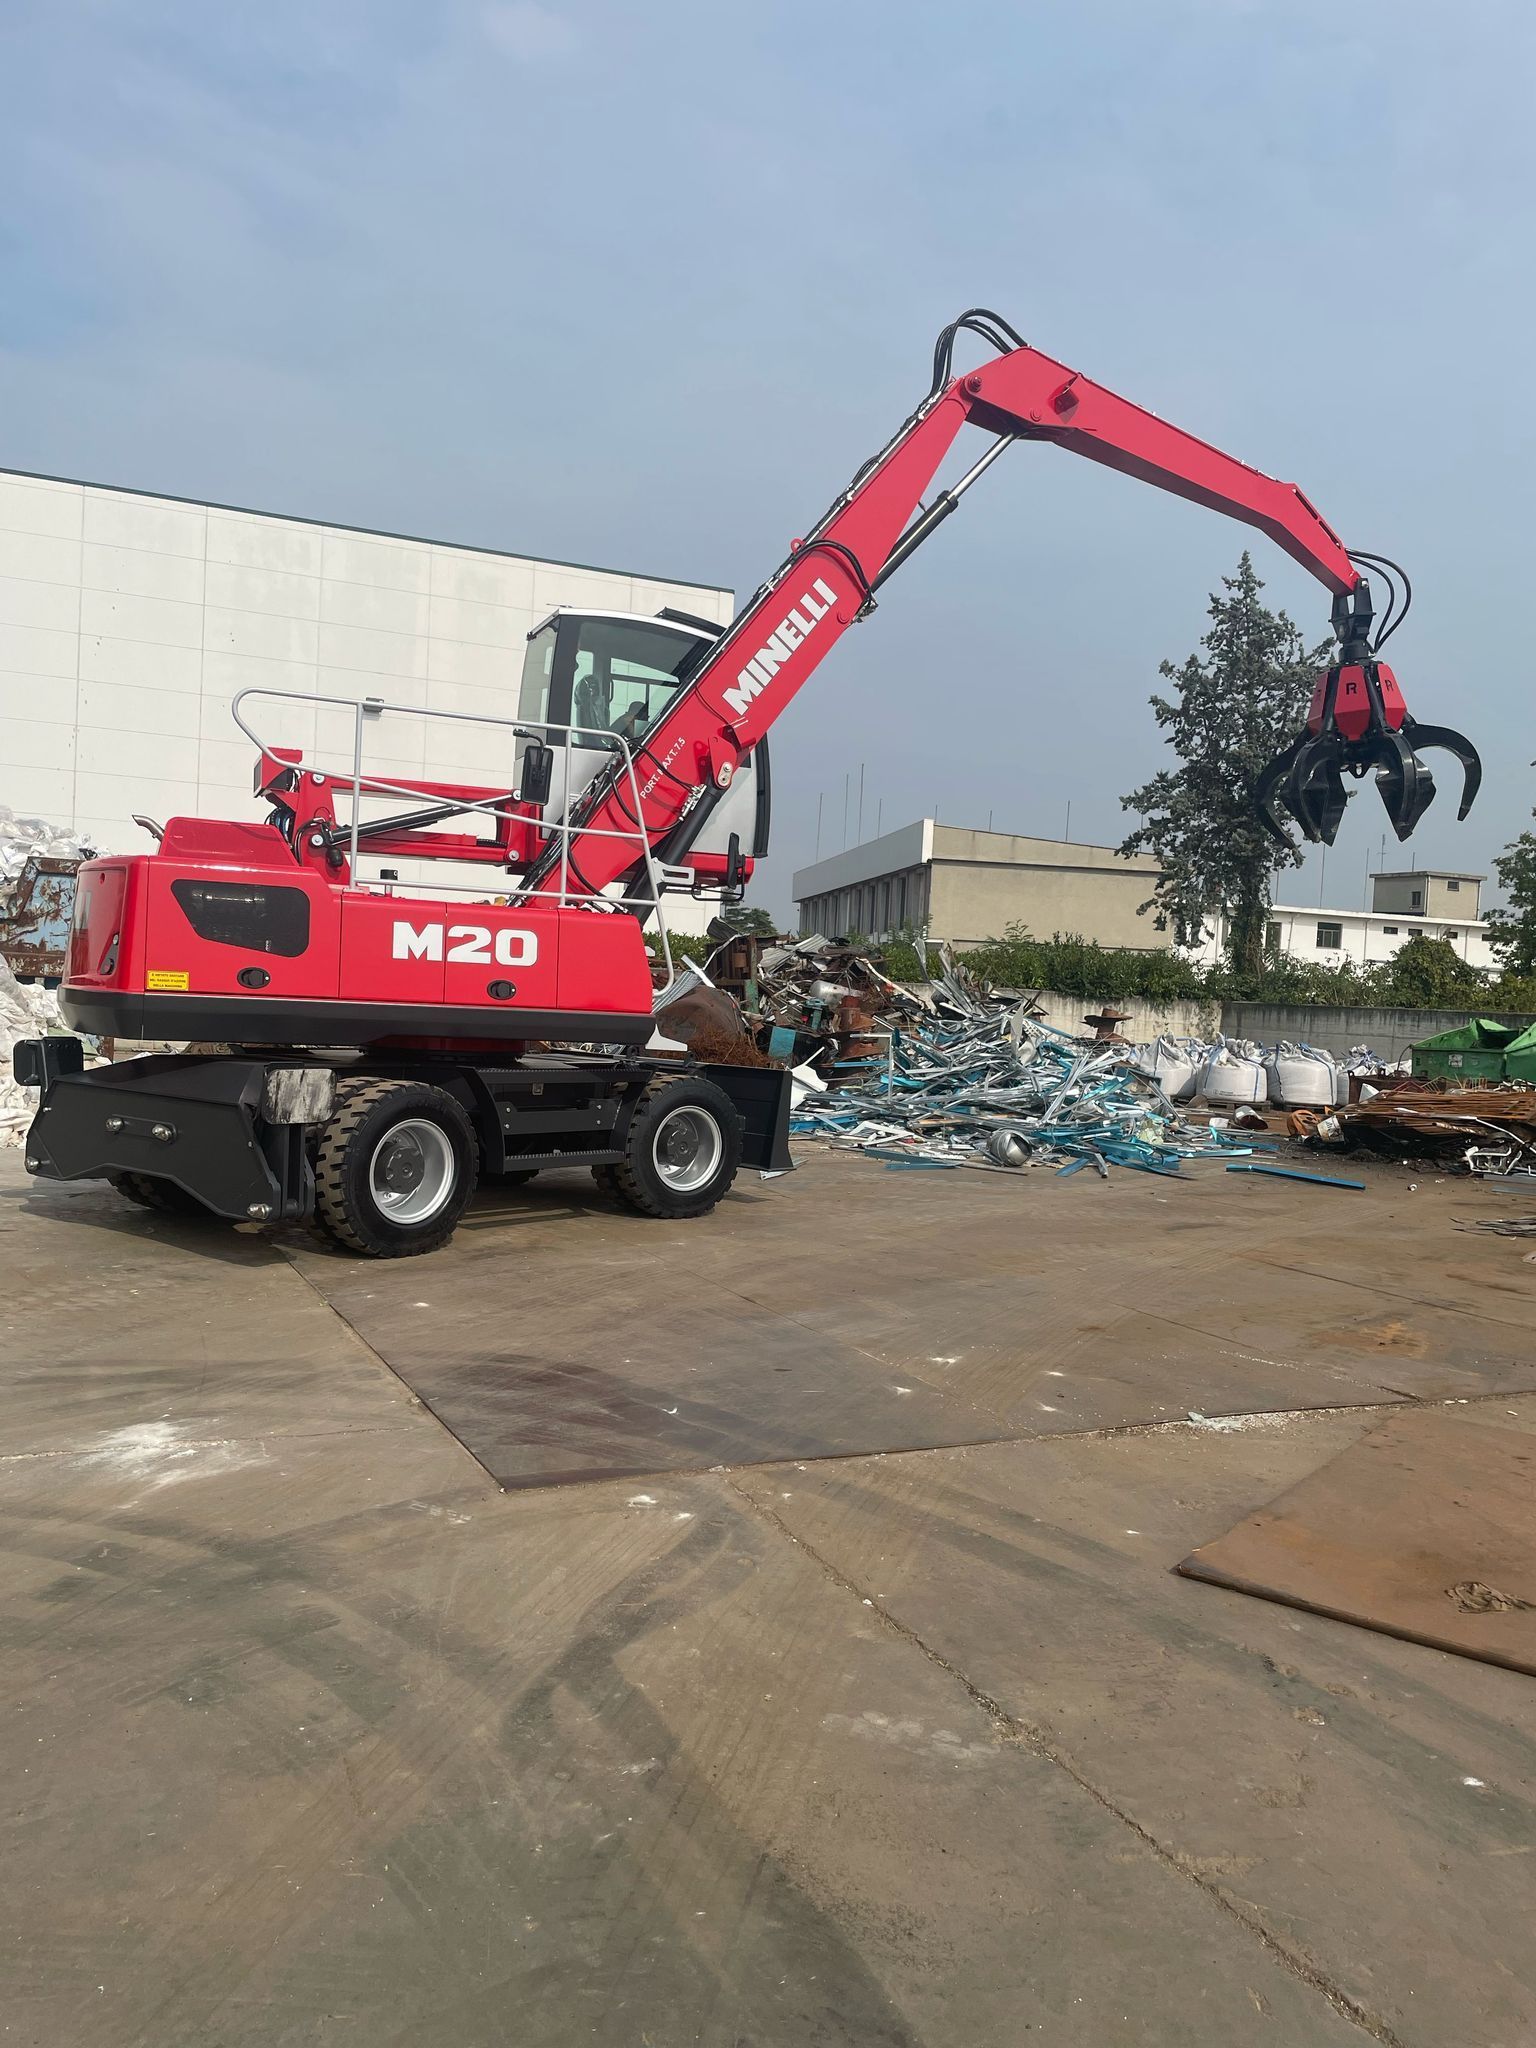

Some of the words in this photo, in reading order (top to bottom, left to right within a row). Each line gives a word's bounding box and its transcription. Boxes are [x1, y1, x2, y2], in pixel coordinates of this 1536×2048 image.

[721, 577, 839, 716] MINELLI
[1346, 682, 1358, 695] R
[640, 774, 661, 799] PORT.
[674, 737, 686, 750] 7.5
[392, 921, 538, 967] M20
